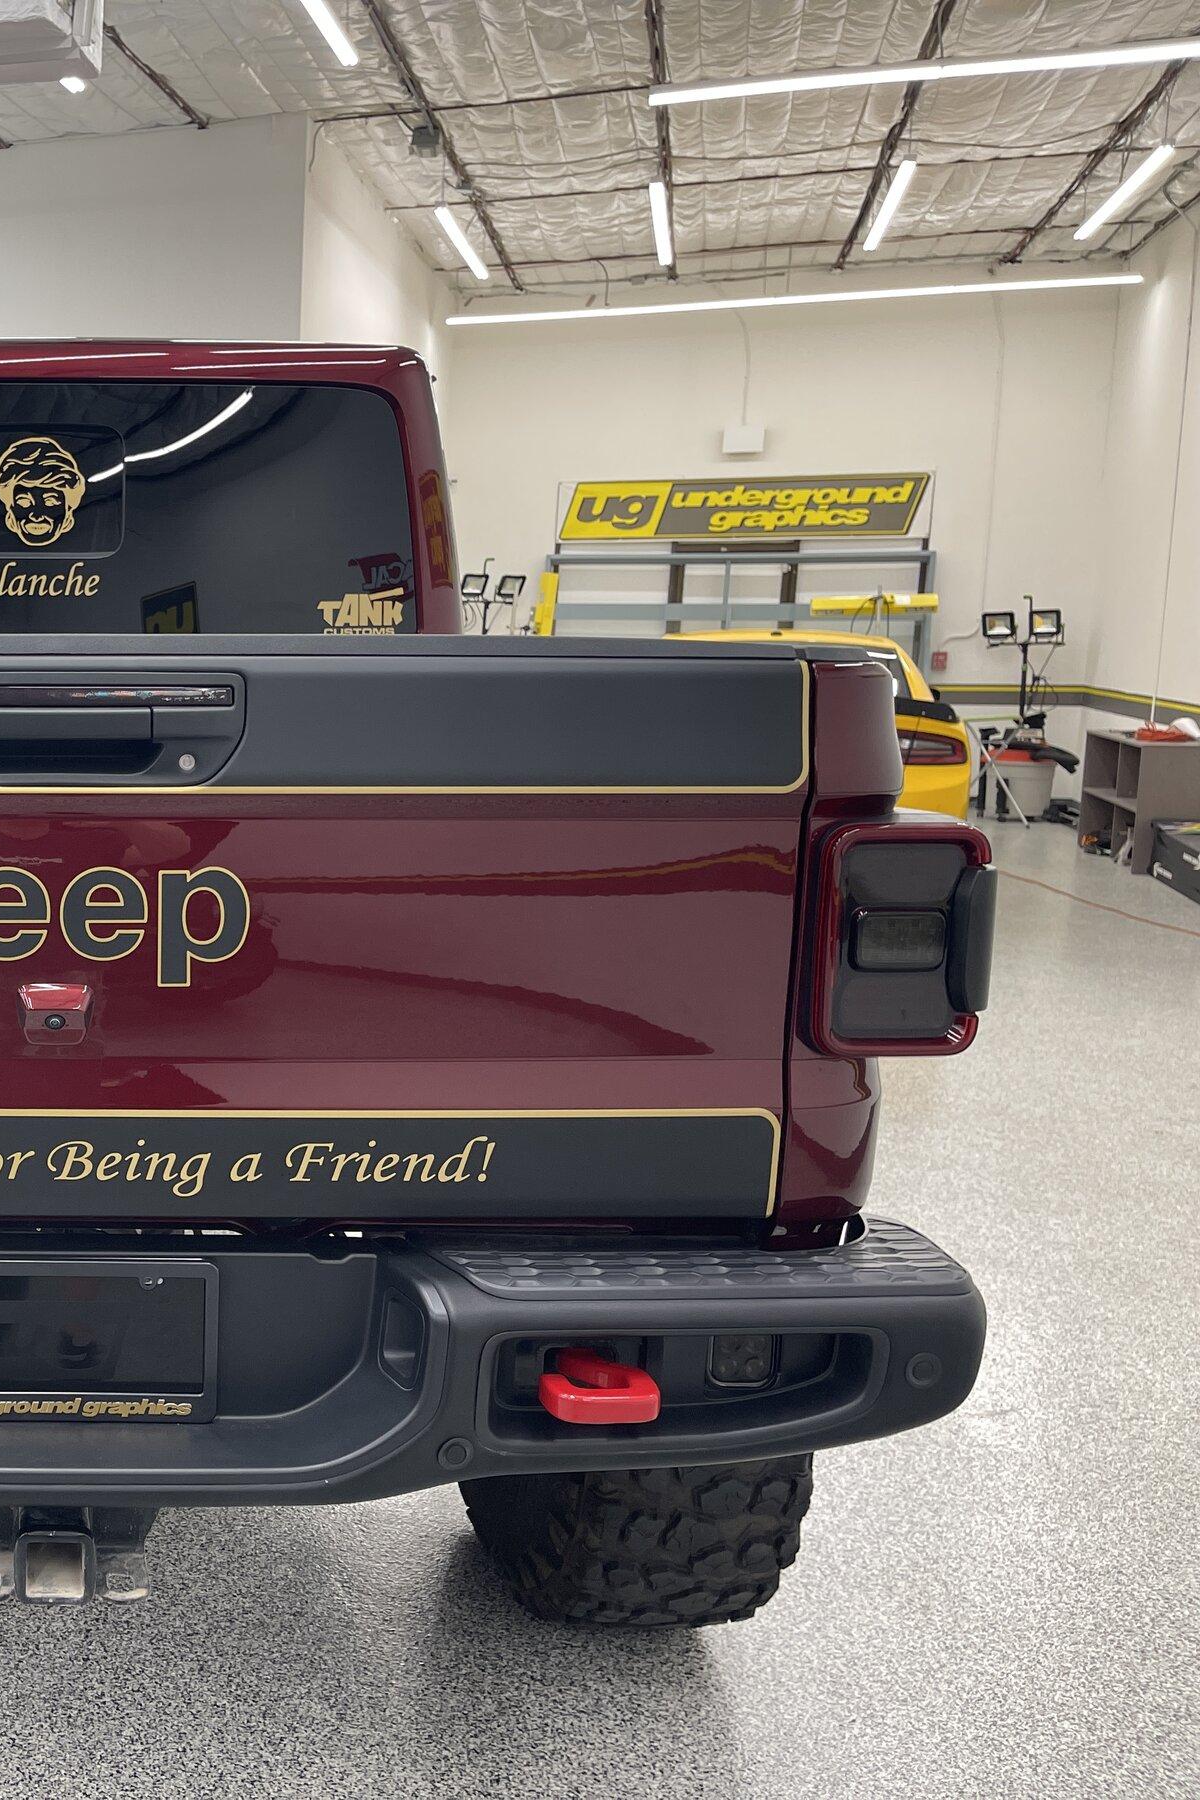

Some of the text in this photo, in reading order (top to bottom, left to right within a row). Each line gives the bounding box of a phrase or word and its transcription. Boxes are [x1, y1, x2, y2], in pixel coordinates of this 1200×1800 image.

[671, 481, 915, 510] underground
[576, 493, 661, 530] ug
[708, 507, 870, 532] graphics
[316, 587, 405, 627] TANK
[323, 627, 396, 635] CUSTOMS
[46, 1139, 212, 1198] Being
[230, 1151, 263, 1182] a
[285, 1135, 497, 1183] Friend!
[81, 1399, 192, 1418] graphics
